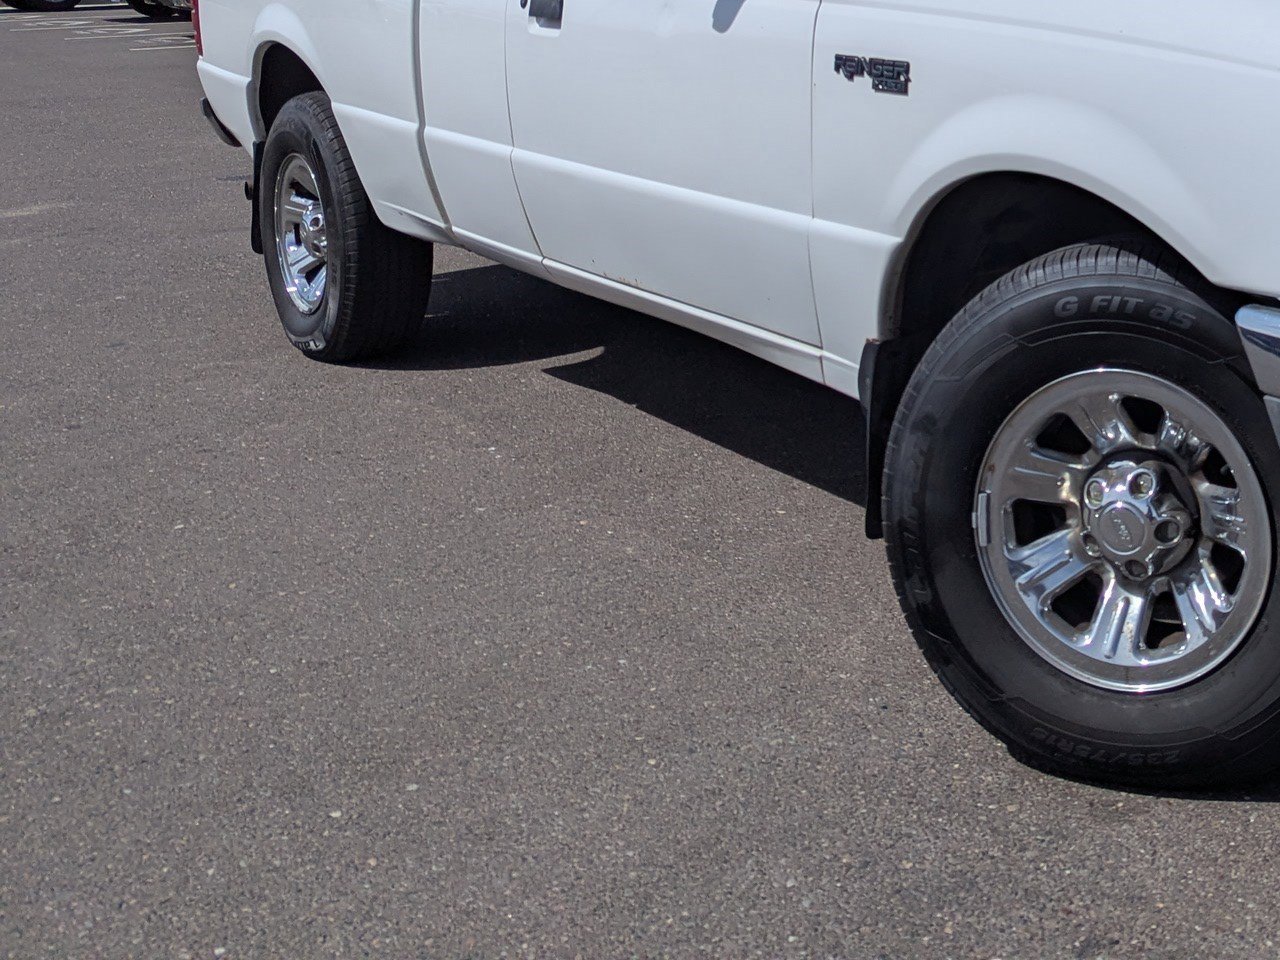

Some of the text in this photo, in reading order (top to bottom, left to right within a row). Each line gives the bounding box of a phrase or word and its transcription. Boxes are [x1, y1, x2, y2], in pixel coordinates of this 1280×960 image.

[834, 53, 912, 83] RANGER
[1053, 295, 1080, 318] G
[1088, 294, 1144, 314] FIT
